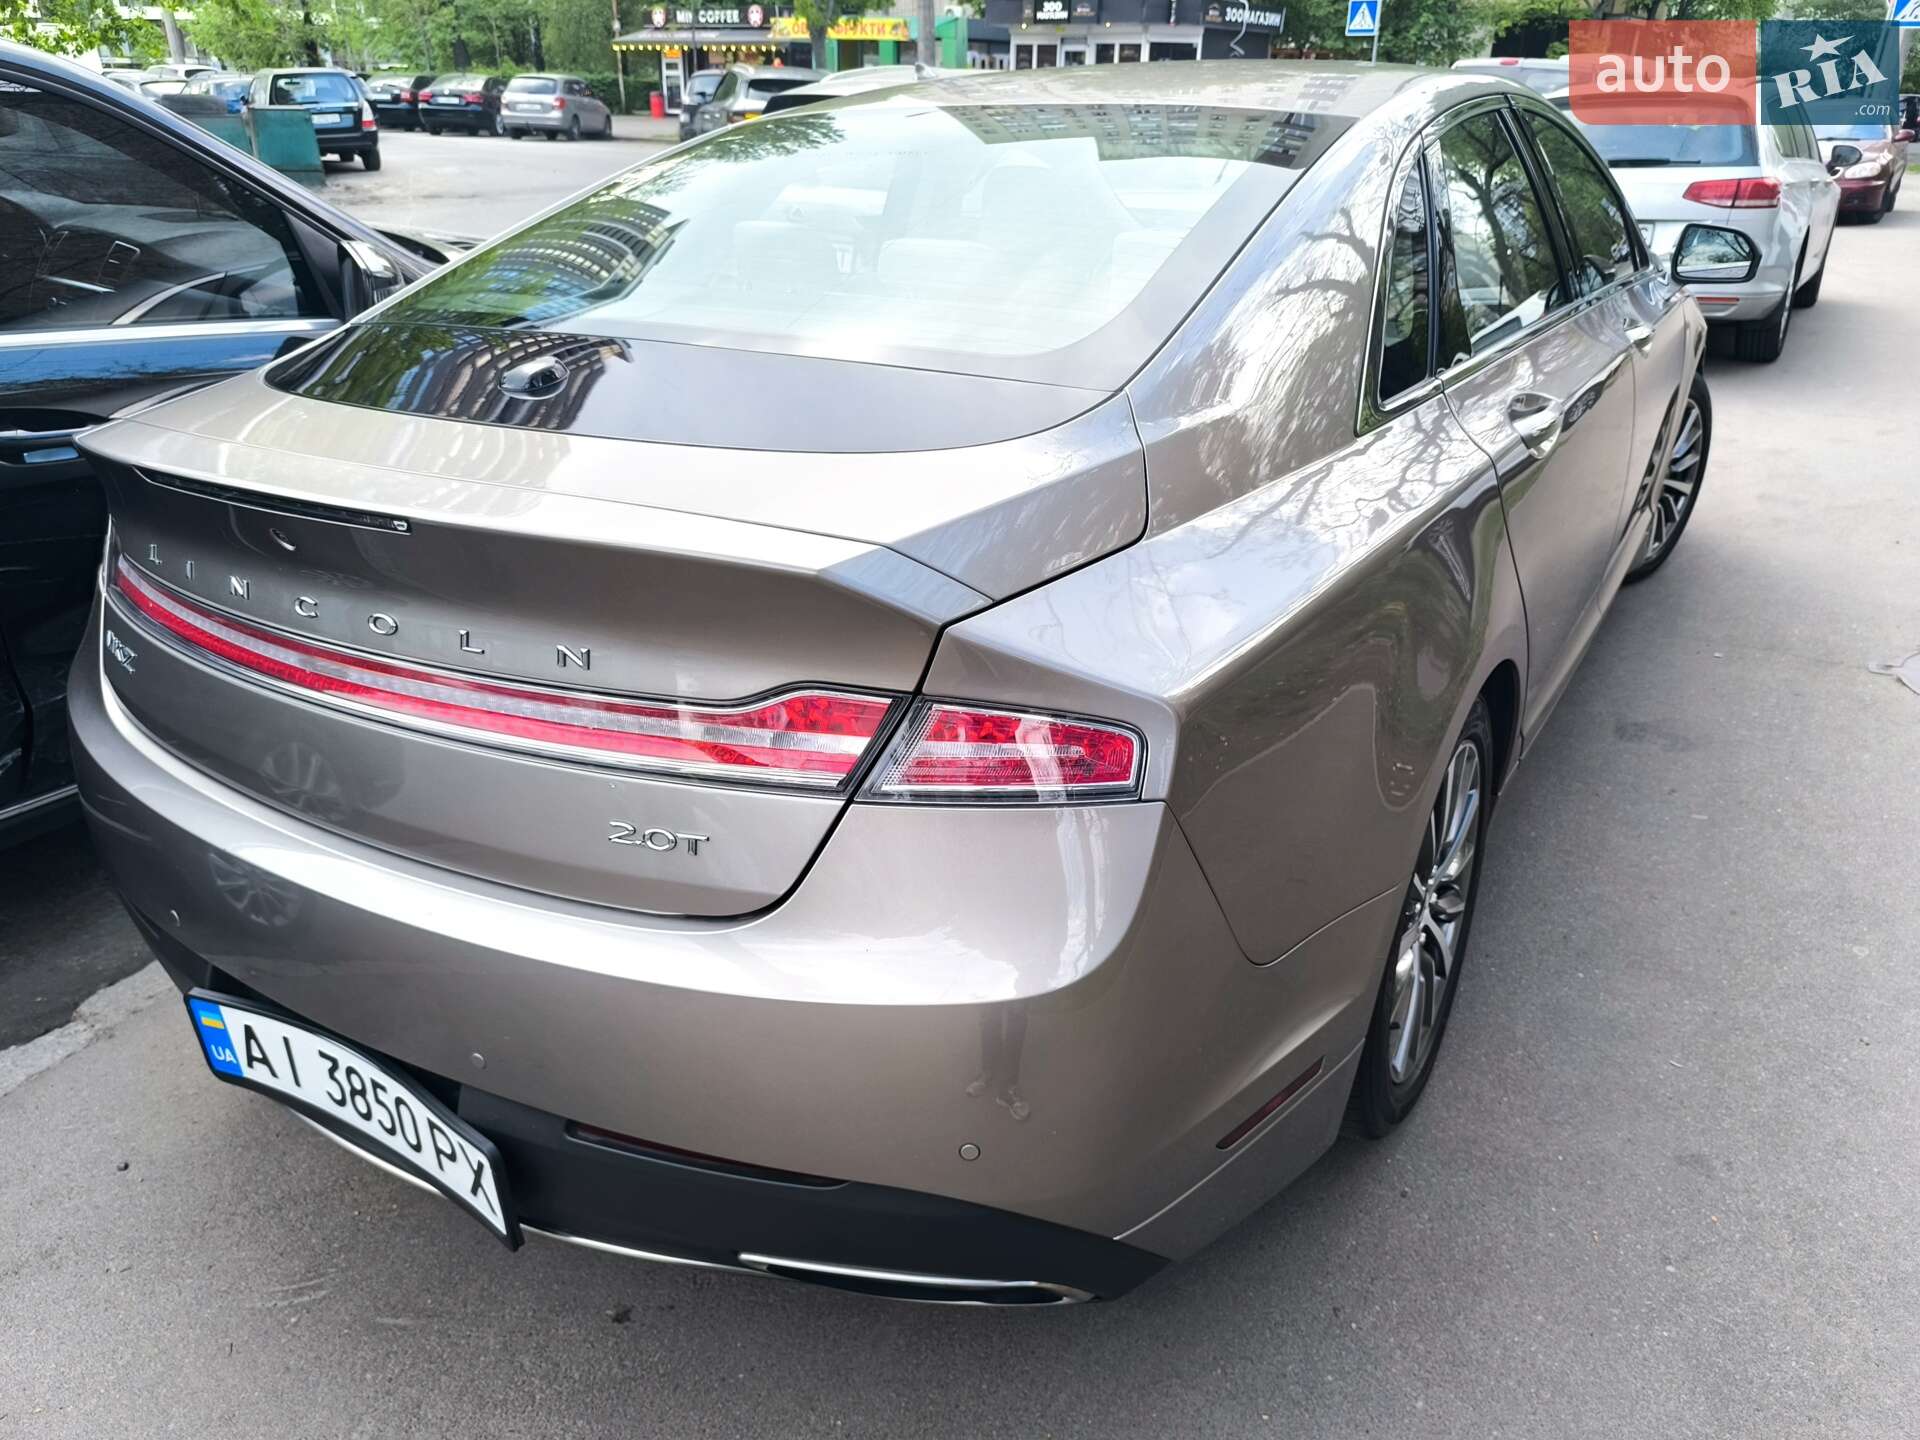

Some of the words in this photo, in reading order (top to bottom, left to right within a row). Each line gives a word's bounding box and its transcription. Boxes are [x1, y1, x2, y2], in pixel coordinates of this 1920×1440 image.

[149, 543, 591, 671] LINCOLN
[608, 821, 709, 855] 2.0T
[211, 1044, 237, 1065] UA
[244, 1023, 302, 1088] AI
[318, 1049, 422, 1153] 3850
[427, 1117, 499, 1217] PX
